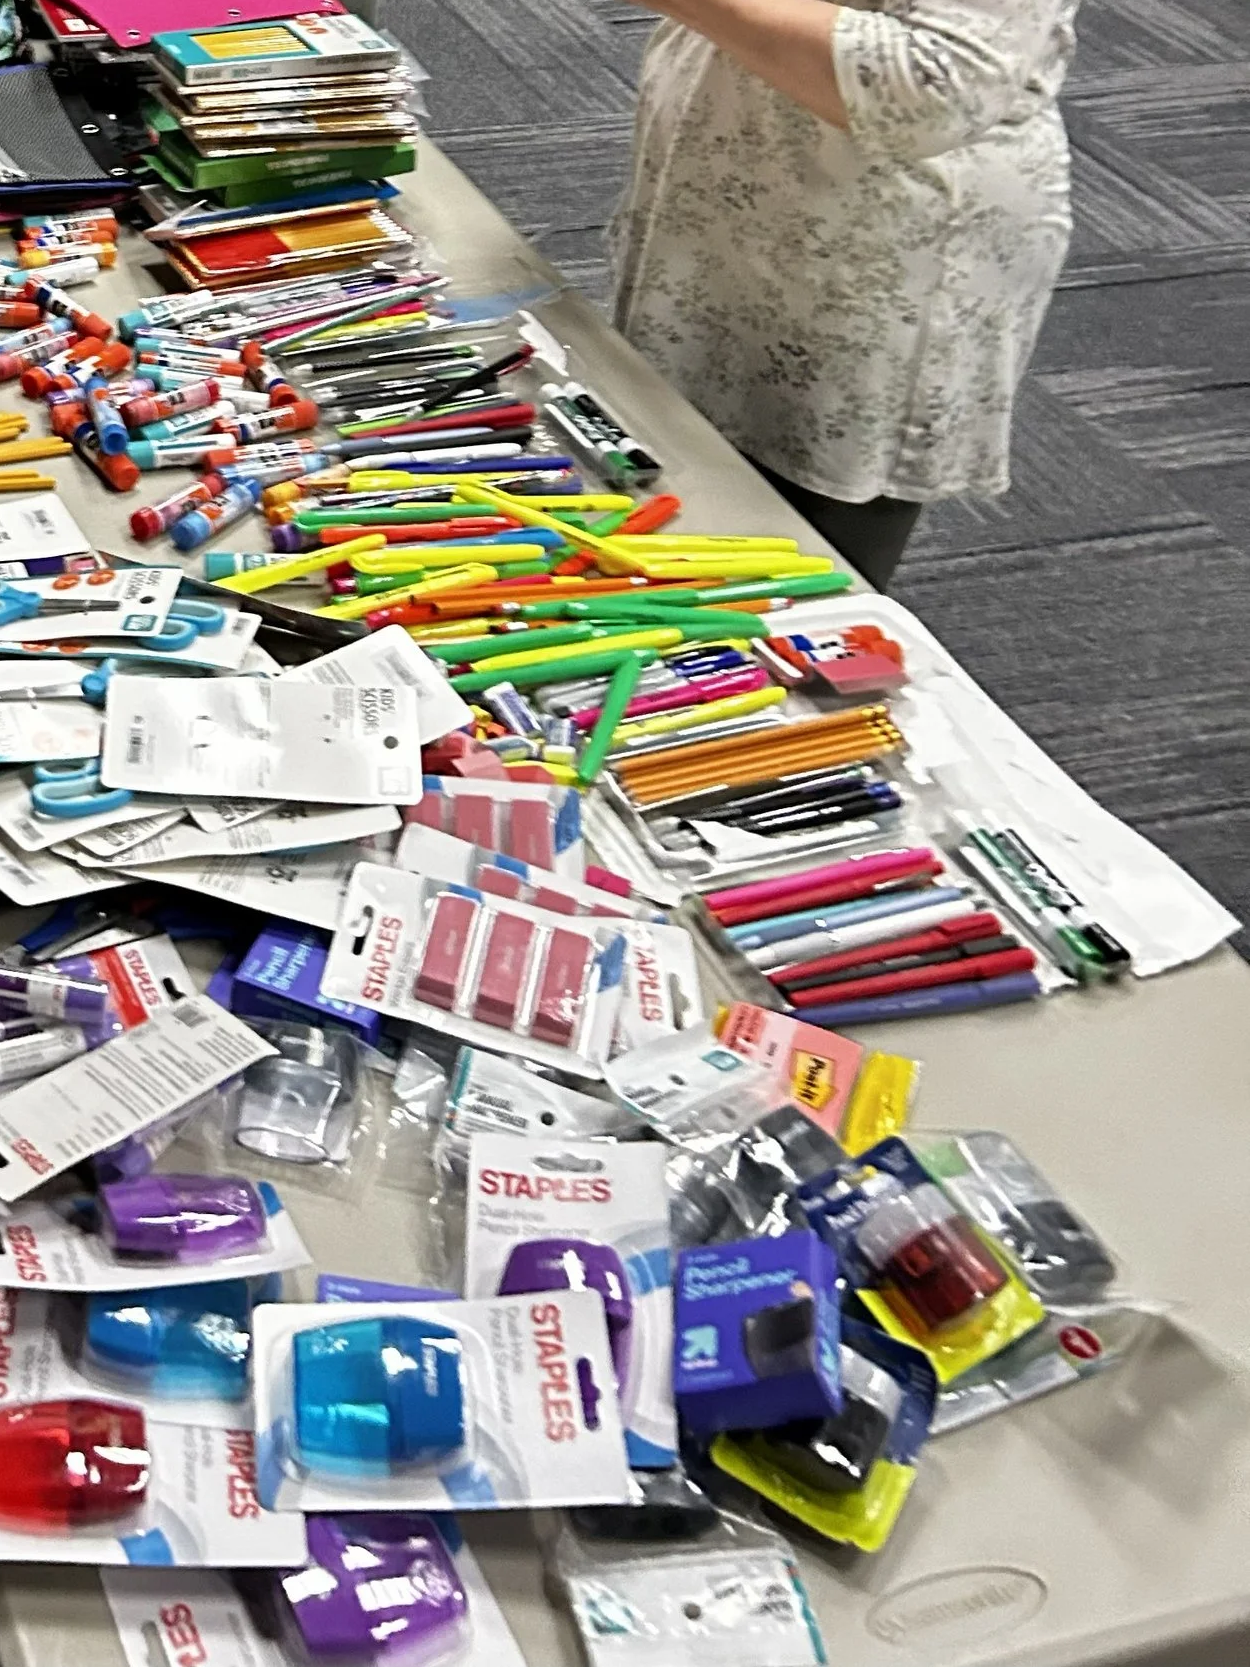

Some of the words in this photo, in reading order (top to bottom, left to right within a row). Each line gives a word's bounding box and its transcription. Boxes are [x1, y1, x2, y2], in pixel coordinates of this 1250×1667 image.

[123, 949, 162, 1006] STAPLES
[254, 946, 289, 986] Pencil
[361, 915, 403, 1002] STAPLES
[797, 1056, 827, 1101] Post-it
[479, 1169, 613, 1204] STAPLES
[6, 1224, 47, 1283] STAPLES
[683, 1256, 751, 1284] Pencil
[682, 1269, 799, 1302] Sharpener
[530, 1301, 578, 1444] STAPLES
